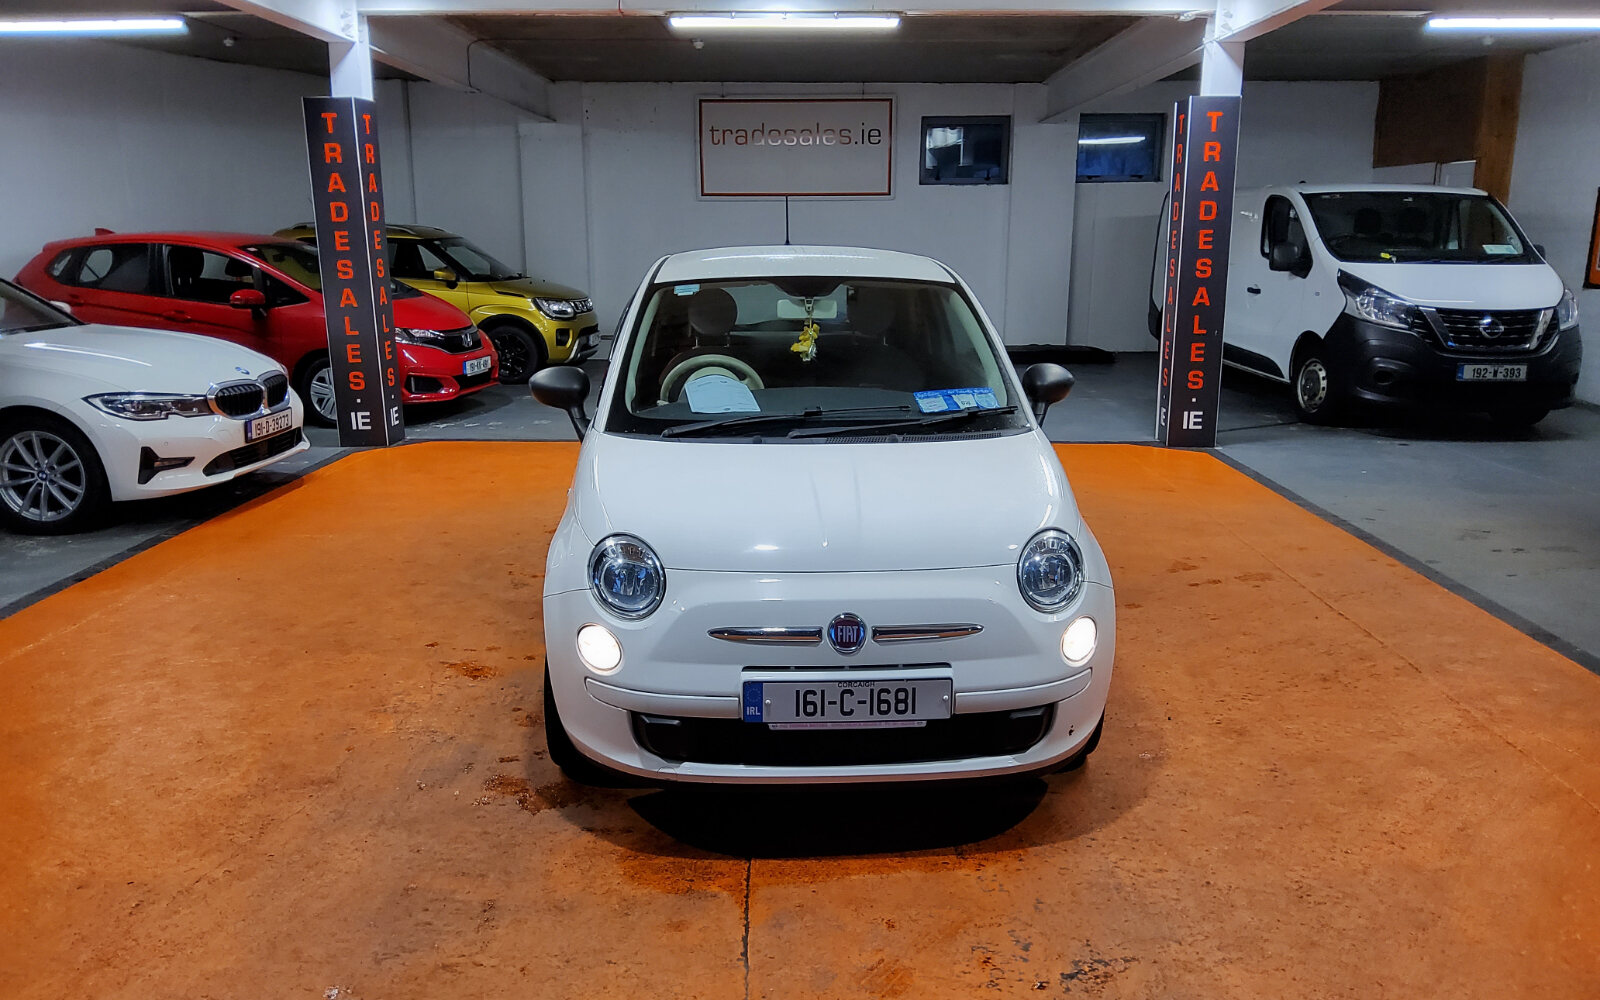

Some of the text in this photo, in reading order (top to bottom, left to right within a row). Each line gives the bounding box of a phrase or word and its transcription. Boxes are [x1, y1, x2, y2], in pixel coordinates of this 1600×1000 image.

[709, 122, 882, 146] tradesales.ie
[837, 625, 859, 643] FIAT
[746, 706, 761, 716] IRL
[794, 687, 917, 718] 161-C-1681
